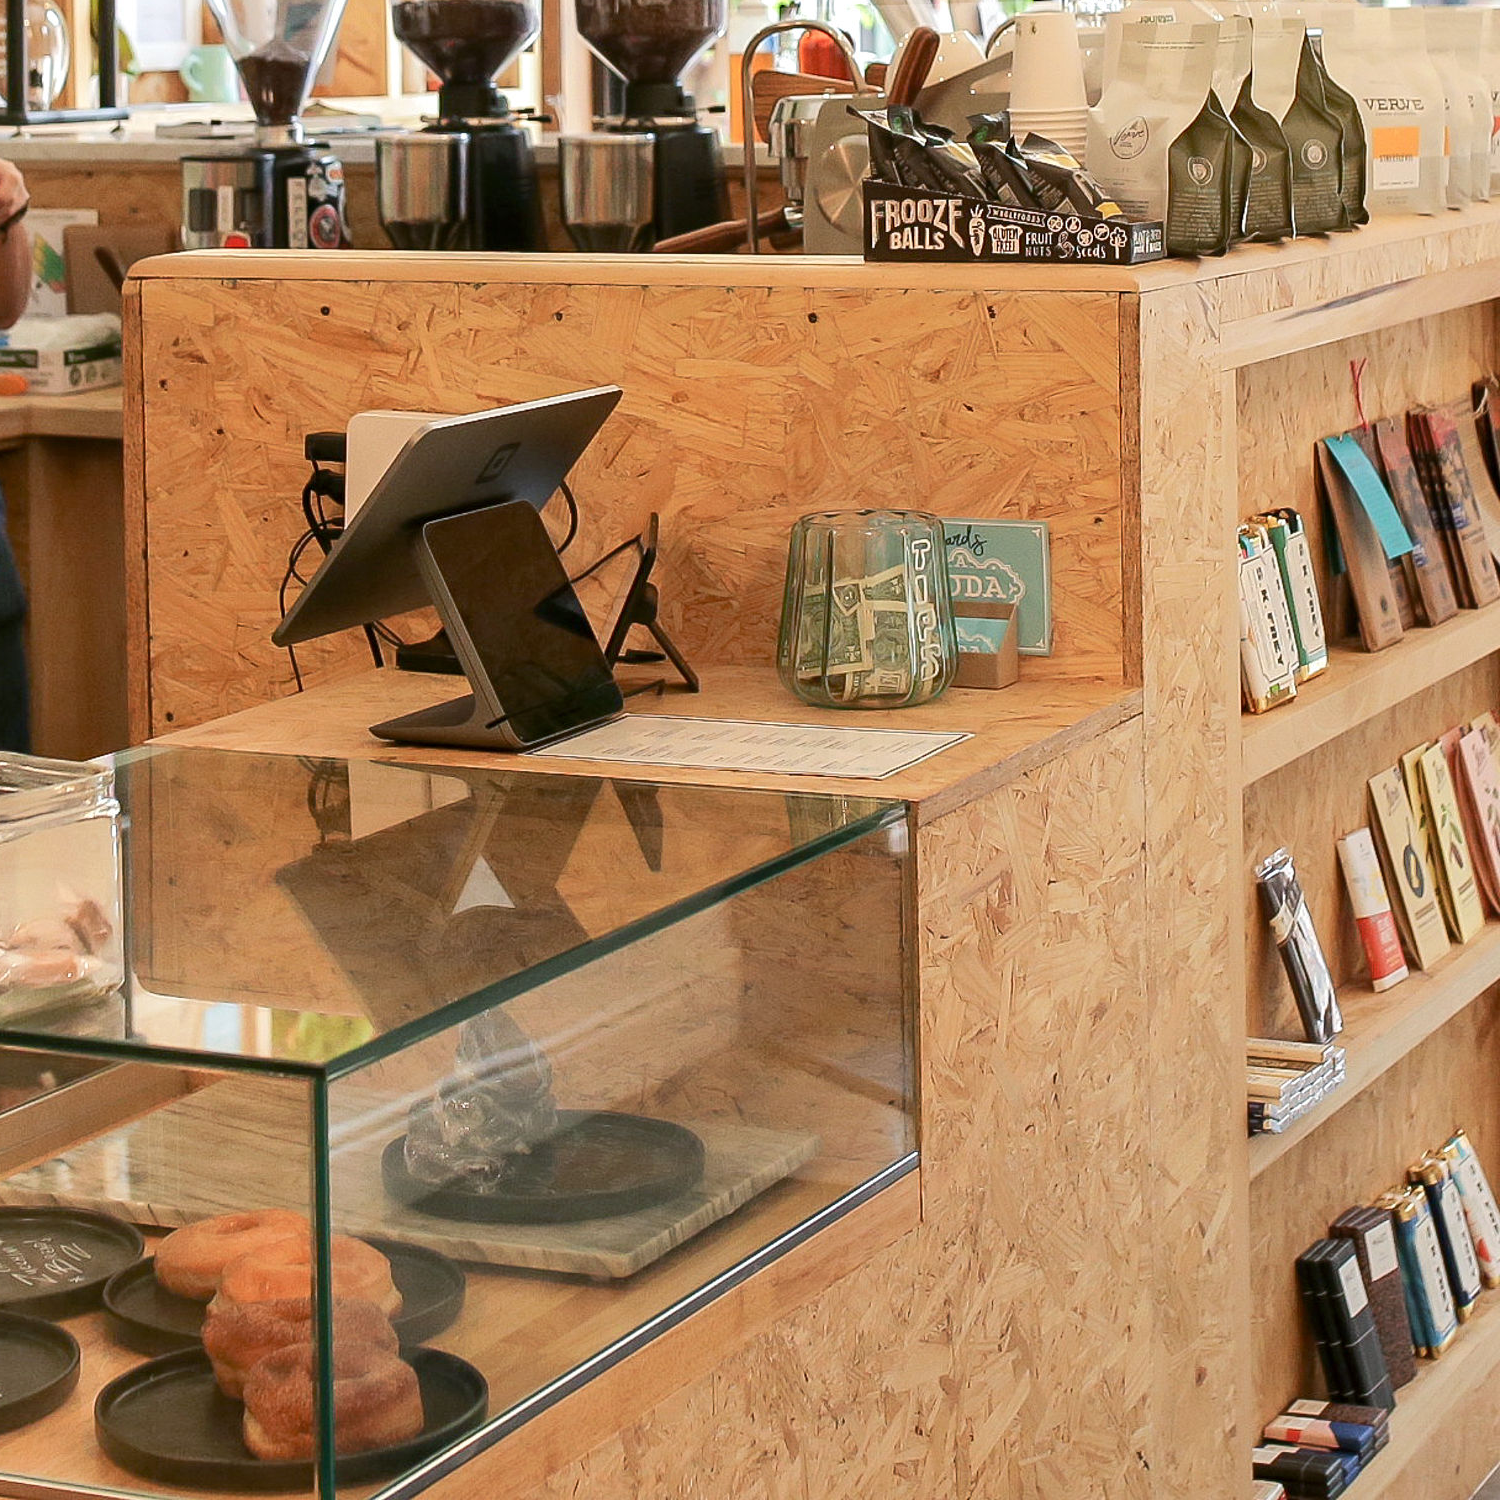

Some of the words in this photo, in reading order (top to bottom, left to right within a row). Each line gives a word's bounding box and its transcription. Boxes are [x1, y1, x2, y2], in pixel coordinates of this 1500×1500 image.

[1363, 98, 1425, 111] VERVE
[871, 199, 964, 249] FROOZE
[889, 225, 945, 250] BALLS
[1025, 231, 1053, 245] FRUIT
[1025, 246, 1052, 257] NUTS
[911, 537, 942, 682] TIPS
